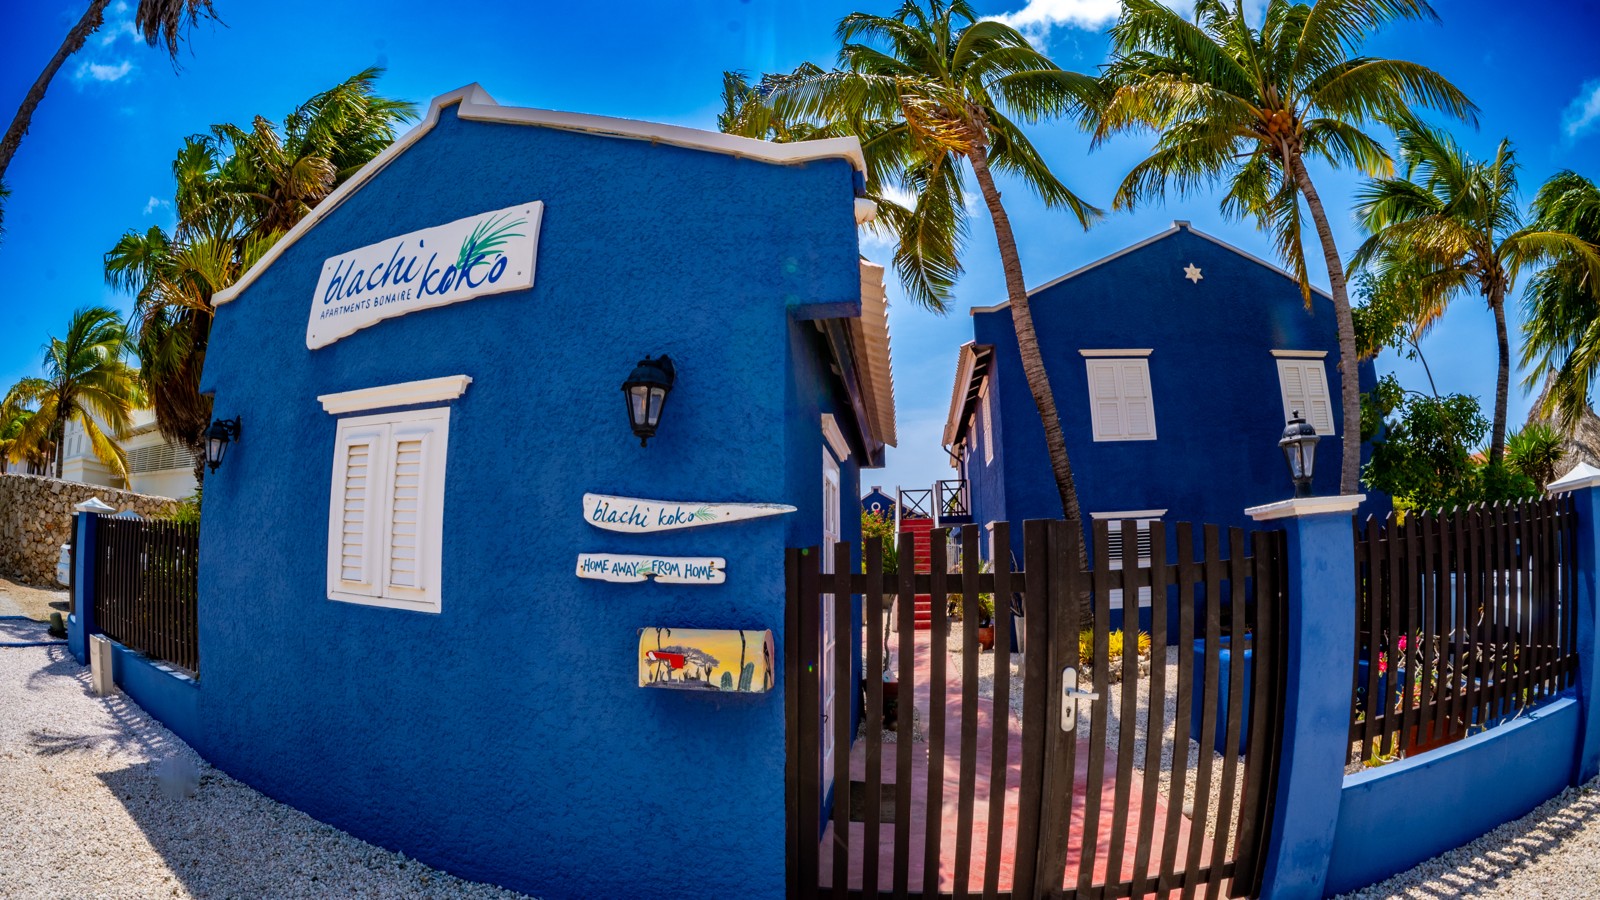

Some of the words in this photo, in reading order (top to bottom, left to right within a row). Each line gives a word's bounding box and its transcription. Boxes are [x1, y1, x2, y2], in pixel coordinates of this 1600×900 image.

[324, 239, 424, 305] blachi
[416, 241, 508, 300] koko
[319, 298, 371, 320] APARTMENTS
[373, 288, 412, 308] BONAIRE
[592, 500, 650, 528] blachi
[658, 506, 695, 527] koko
[582, 558, 609, 574] HOME
[611, 562, 639, 578] AWAY
[651, 559, 681, 577] FROM
[684, 563, 716, 579] HOME
